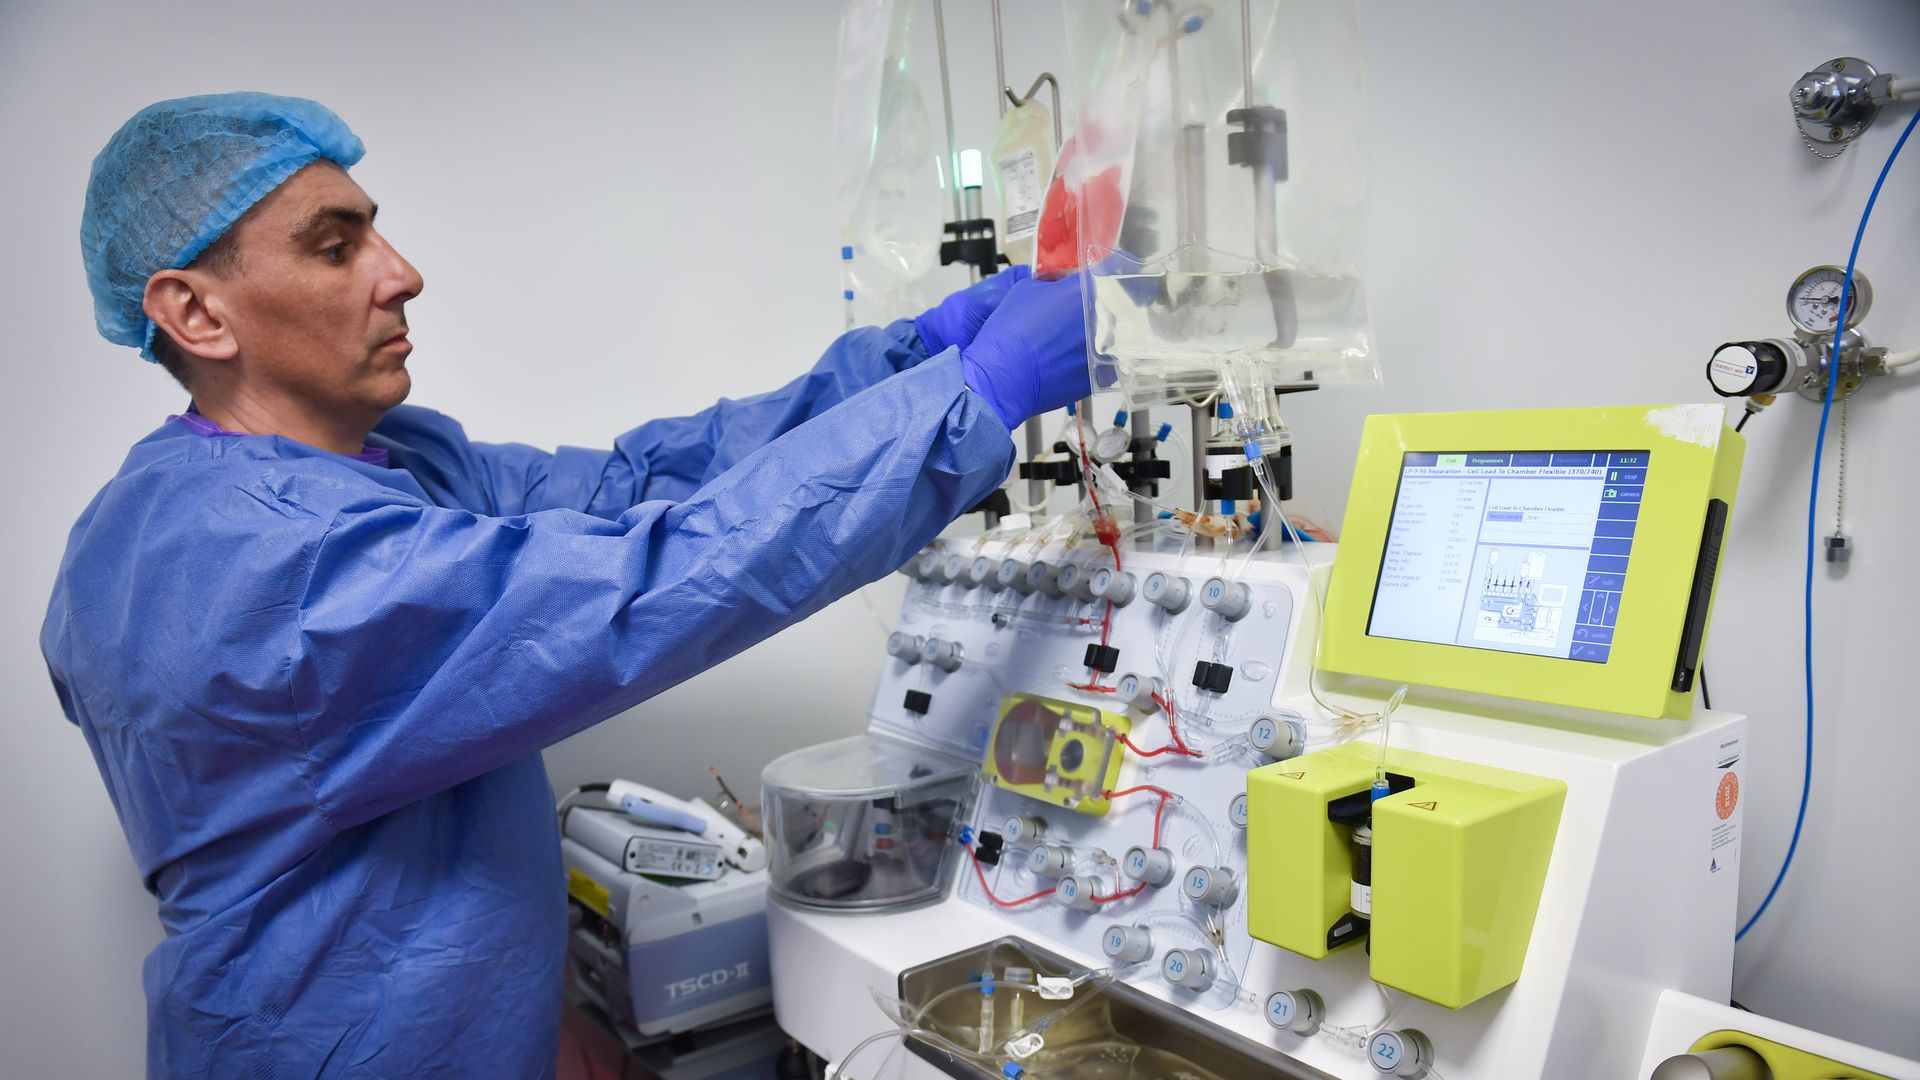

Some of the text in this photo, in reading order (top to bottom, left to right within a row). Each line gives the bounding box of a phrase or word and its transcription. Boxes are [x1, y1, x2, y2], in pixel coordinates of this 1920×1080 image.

[1623, 472, 1638, 480] stop
[1100, 576, 1106, 586] 8
[1152, 582, 1159, 591] 9
[1208, 587, 1219, 598] 10
[1127, 682, 1136, 694] 11
[1258, 727, 1271, 739] 12
[1009, 825, 1017, 834] 16
[1035, 854, 1044, 863] 17
[1133, 857, 1143, 868] 14
[1193, 877, 1203, 888] 15
[1065, 885, 1075, 896] 18
[1111, 935, 1121, 947] 19
[1170, 960, 1183, 973] 20
[1273, 1002, 1288, 1016] 21
[1377, 1043, 1395, 1059] 22
